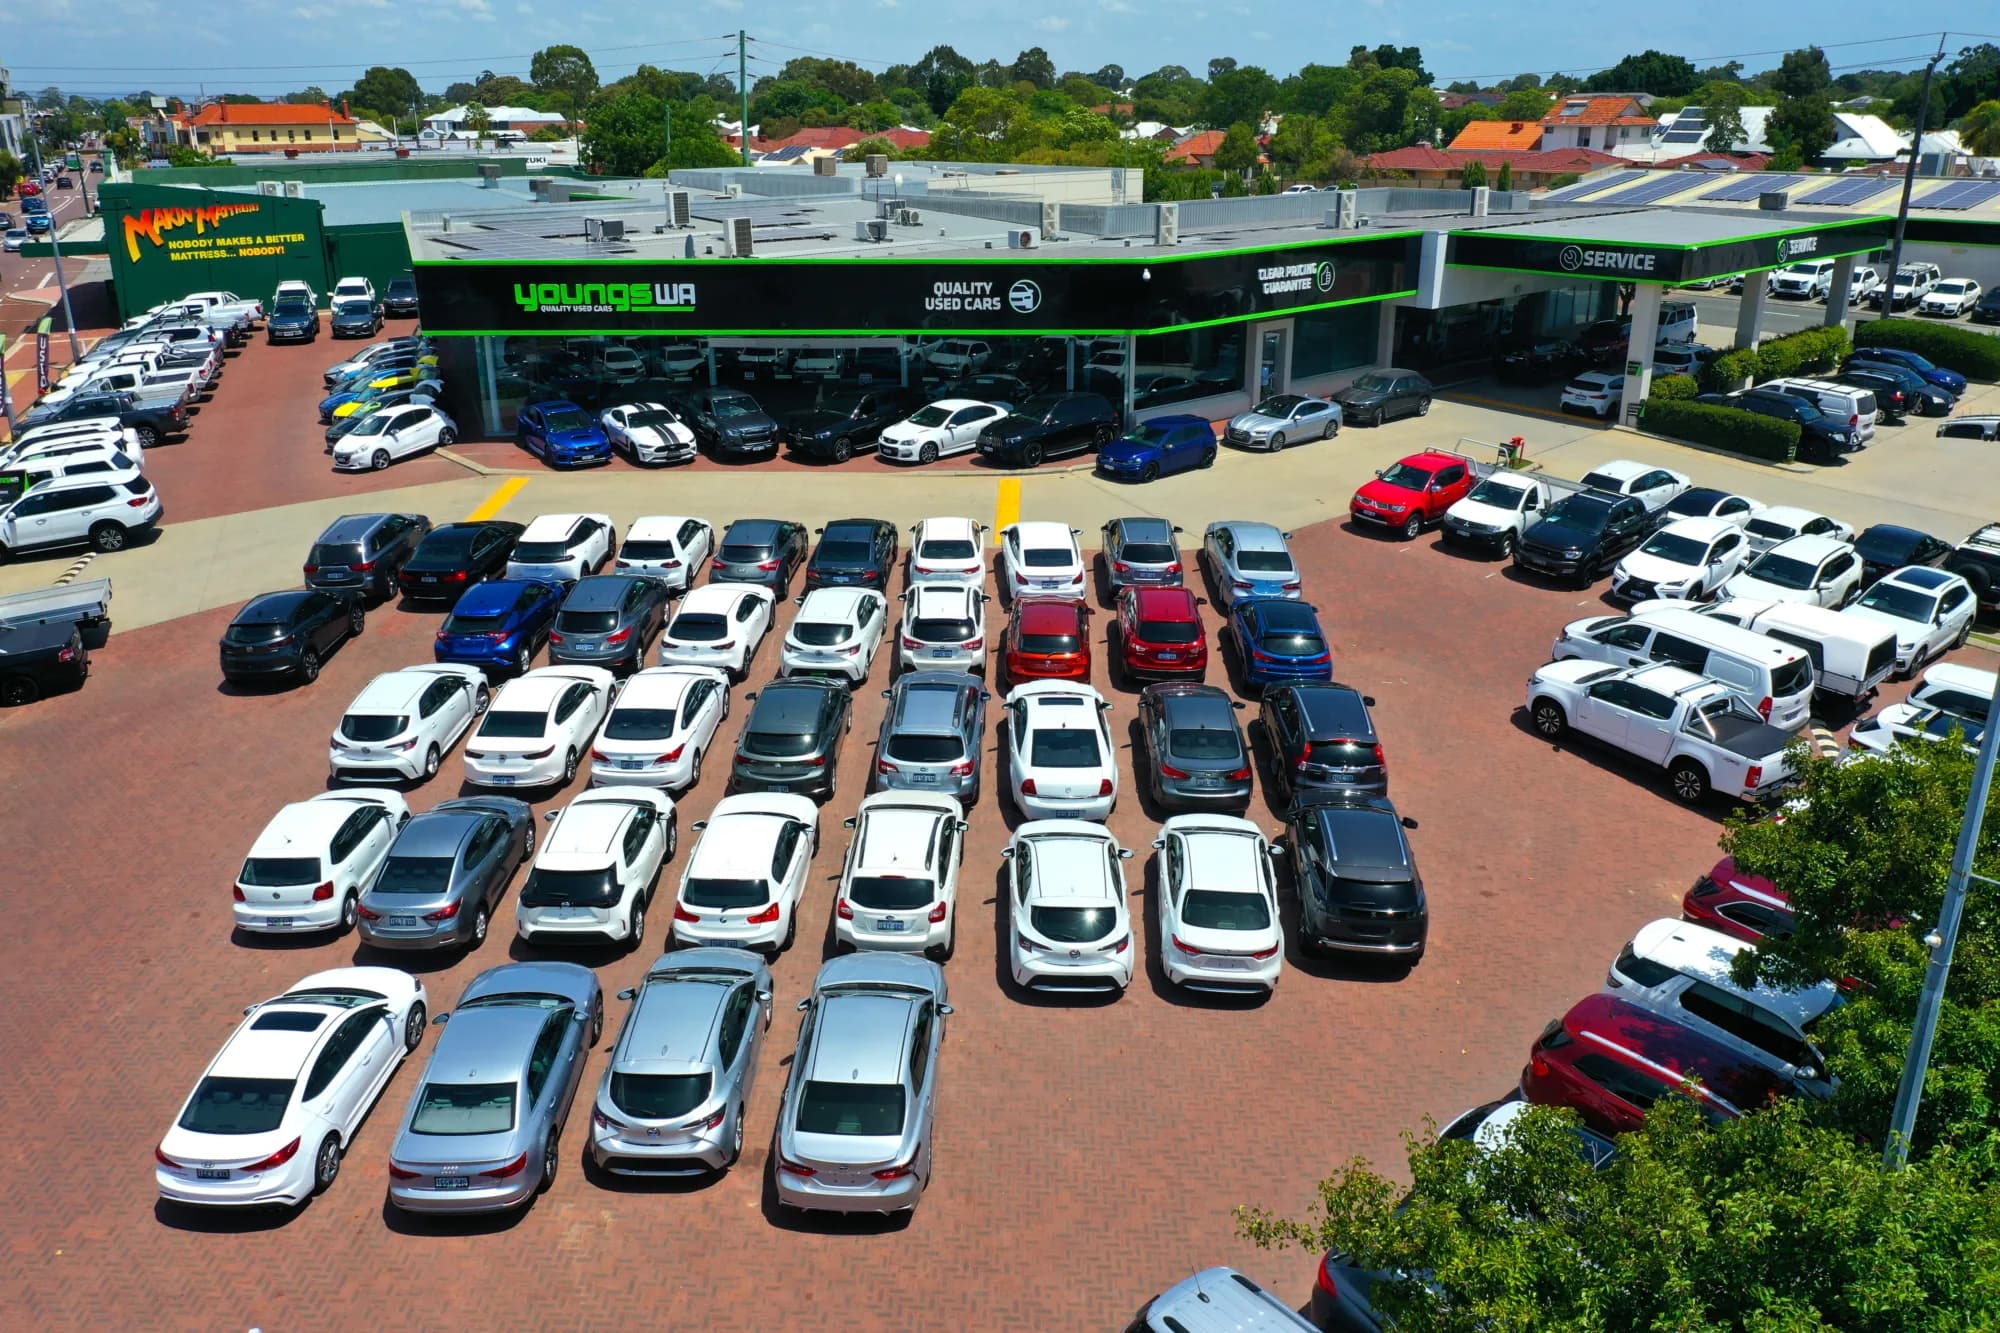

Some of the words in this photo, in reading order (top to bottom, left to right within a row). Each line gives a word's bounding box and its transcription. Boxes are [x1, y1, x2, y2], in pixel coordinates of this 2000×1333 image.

[122, 206, 194, 263] MAKIN
[168, 239, 213, 249] NOBODY
[216, 236, 253, 246] MAKES
[256, 236, 264, 244] A
[265, 233, 305, 244] BETTER
[170, 249, 237, 261] MATTRESS...
[239, 245, 285, 257] NOBODY!
[1788, 236, 1818, 254] SERVICE
[1583, 250, 1656, 271] SERVICE
[1257, 266, 1285, 280] CLEAR
[1285, 262, 1317, 277] PRICING
[933, 281, 993, 297] QUALITY
[1263, 277, 1312, 294] GUARANTEE
[540, 304, 572, 313] QUALITY
[572, 304, 593, 313] USED
[593, 304, 613, 312] CARS
[925, 297, 961, 310] USED
[964, 297, 1001, 310] CARS
